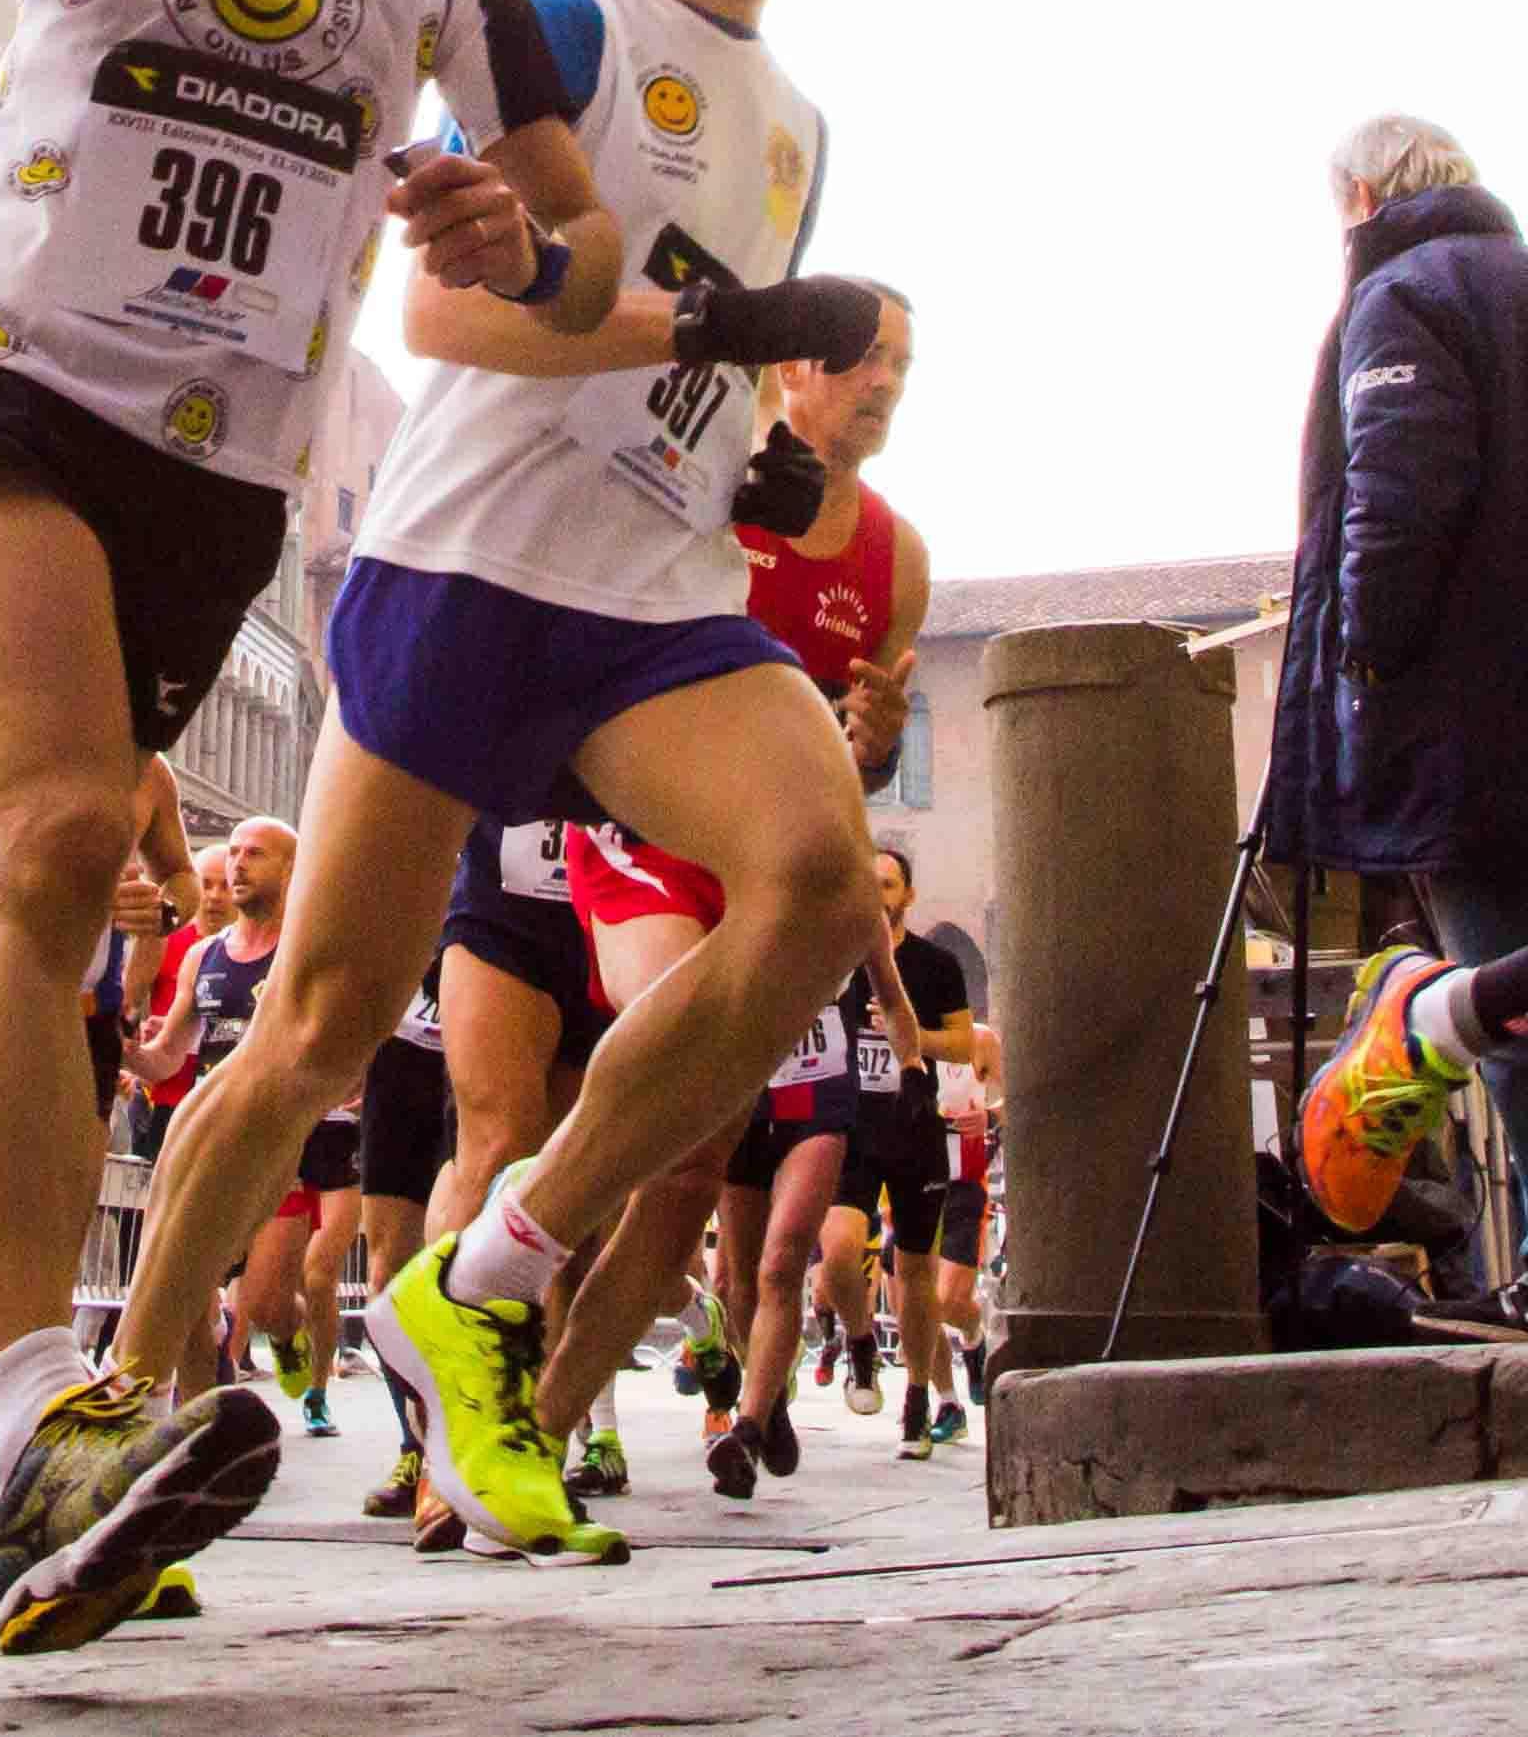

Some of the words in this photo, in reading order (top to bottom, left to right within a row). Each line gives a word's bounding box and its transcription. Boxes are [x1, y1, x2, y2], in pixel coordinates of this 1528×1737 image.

[174, 73, 348, 151] DIADORA
[137, 147, 284, 277] 396
[646, 363, 730, 453] 397
[857, 1046, 891, 1075] 372
